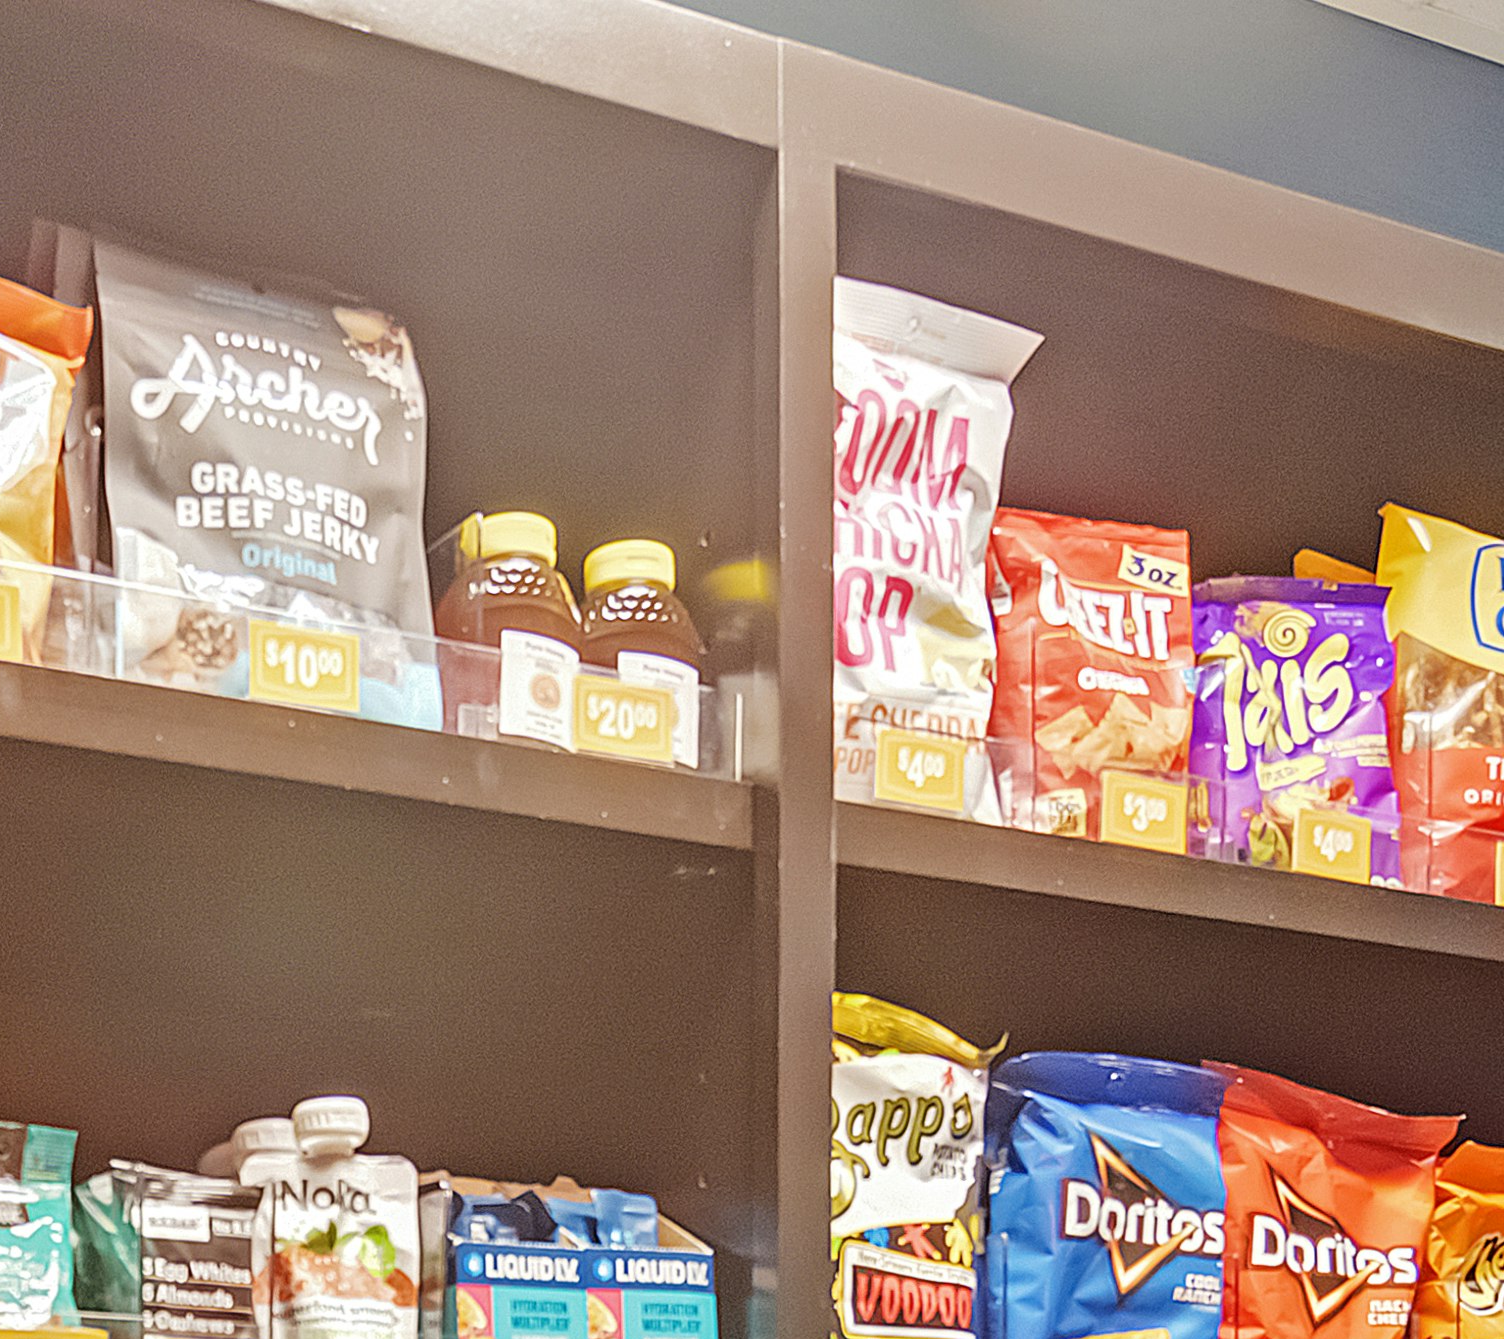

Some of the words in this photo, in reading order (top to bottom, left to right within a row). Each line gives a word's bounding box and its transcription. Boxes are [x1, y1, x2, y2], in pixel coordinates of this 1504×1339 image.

[130, 333, 382, 466] Archer
[175, 495, 276, 530] BEEF
[283, 511, 382, 567] JERKY
[191, 462, 369, 530] GRASS-FED
[1065, 1180, 1225, 1255] Doritos
[1251, 1213, 1419, 1286] Doritos
